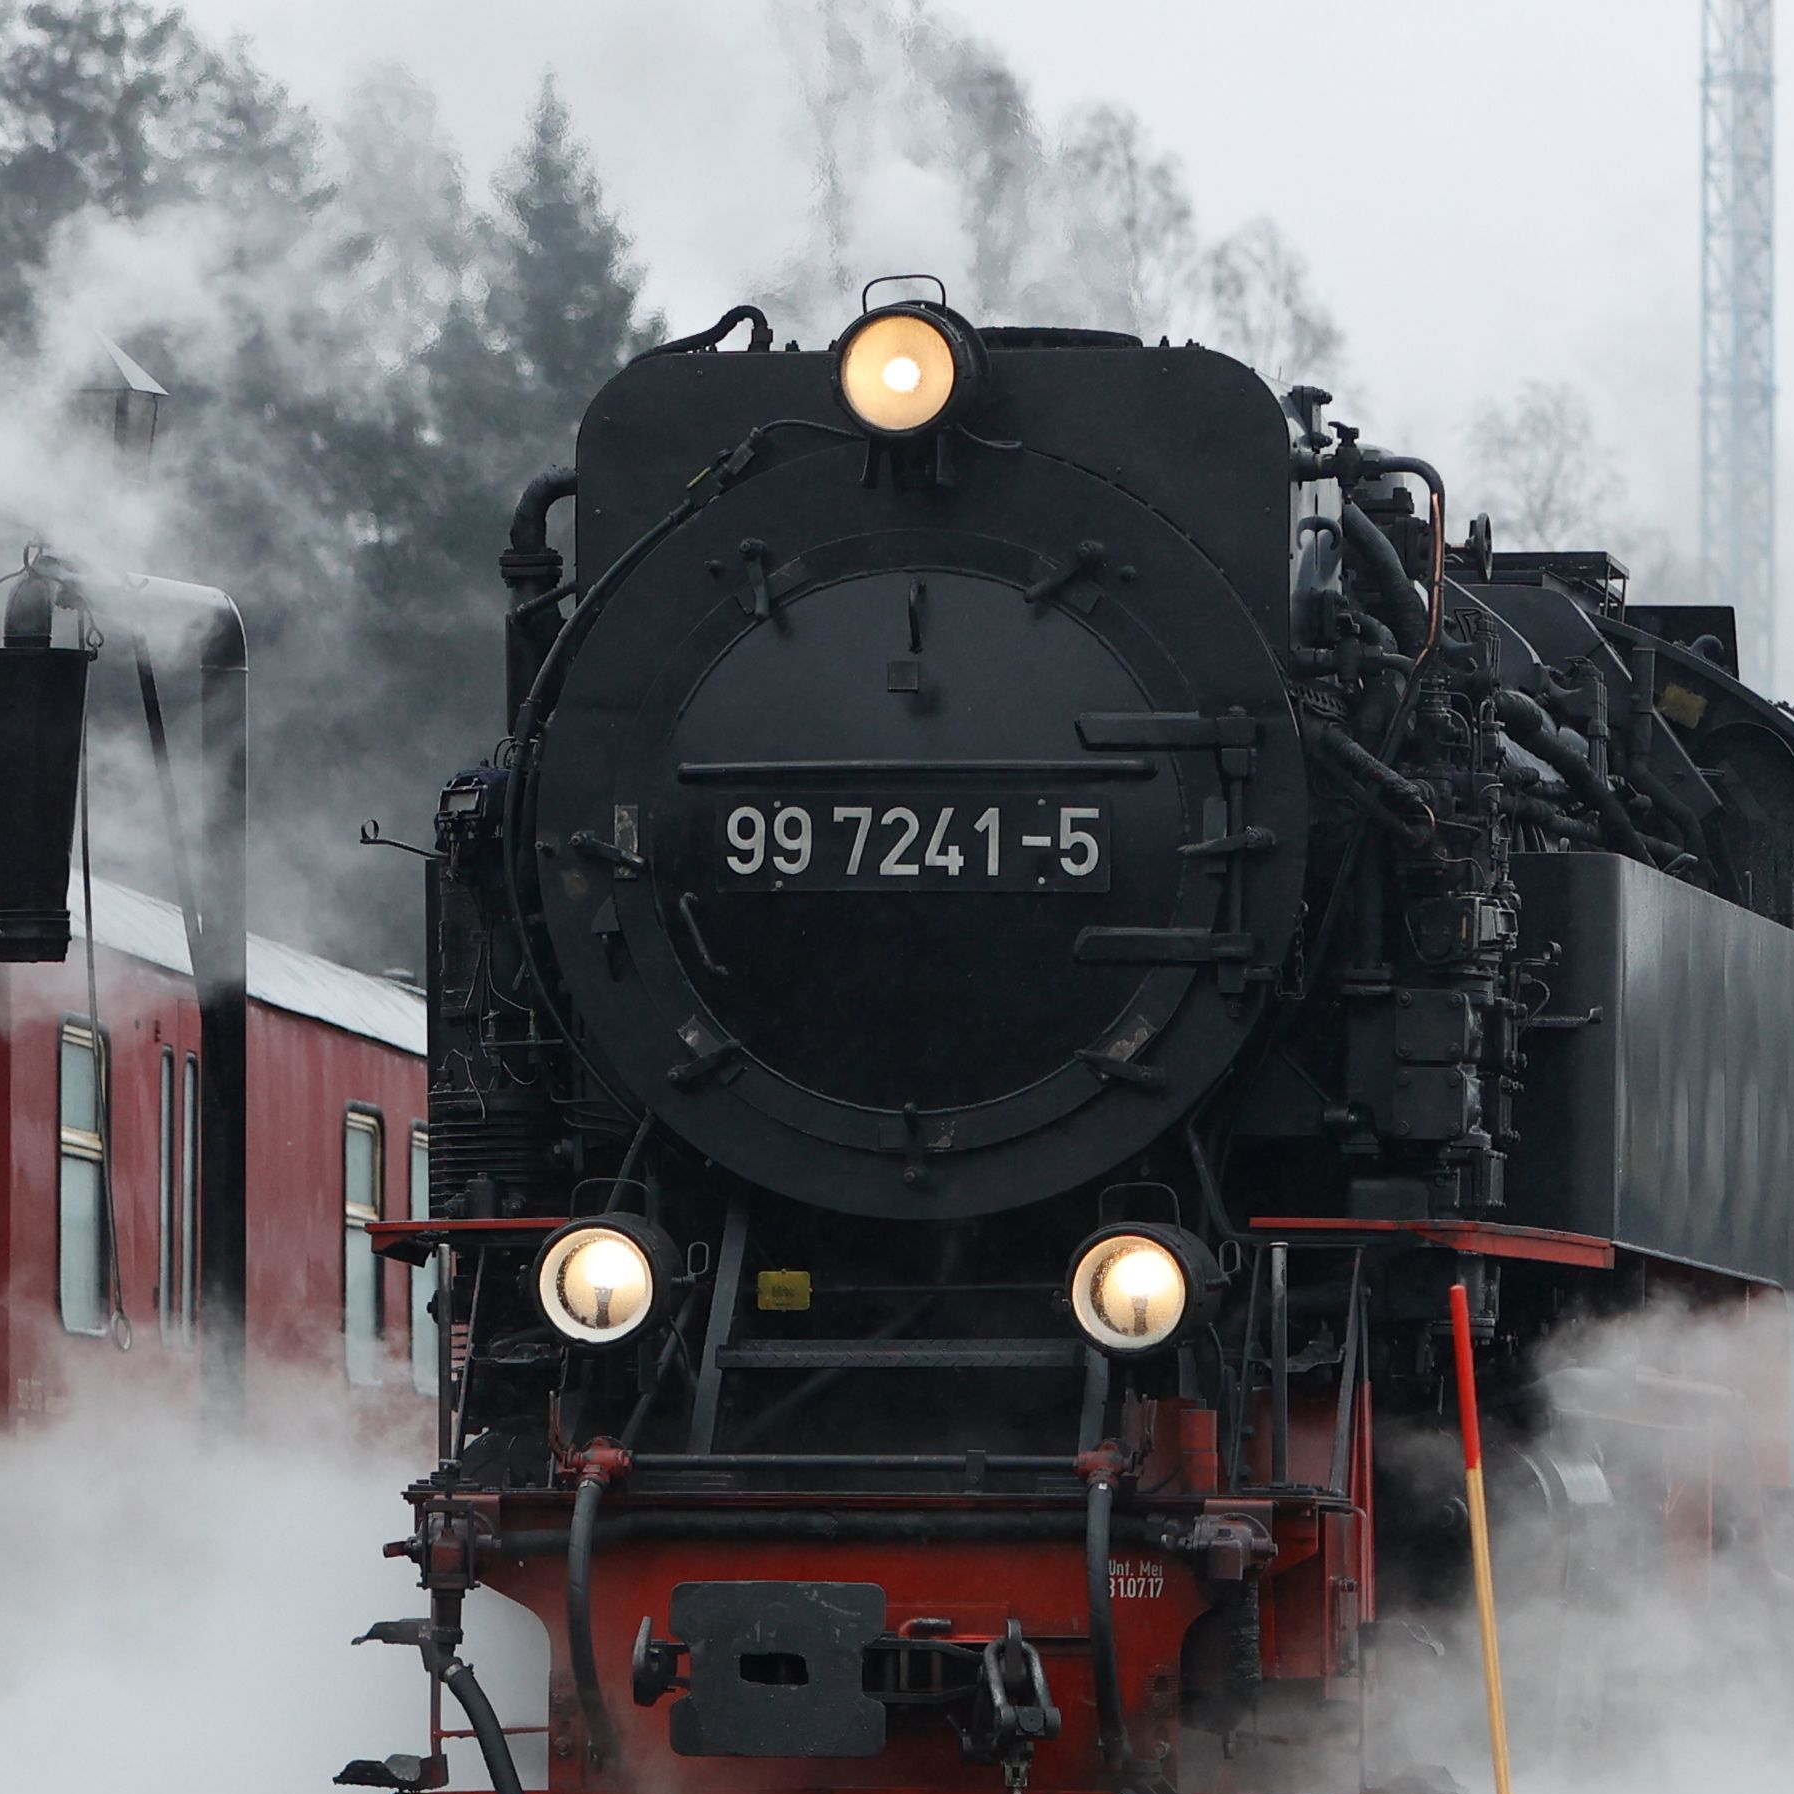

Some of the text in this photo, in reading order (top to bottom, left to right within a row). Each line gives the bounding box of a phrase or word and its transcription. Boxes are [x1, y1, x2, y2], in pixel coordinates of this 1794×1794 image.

[726, 806, 1100, 876] 99 7241-5
[1108, 1560, 1163, 1577] Unt. Mei
